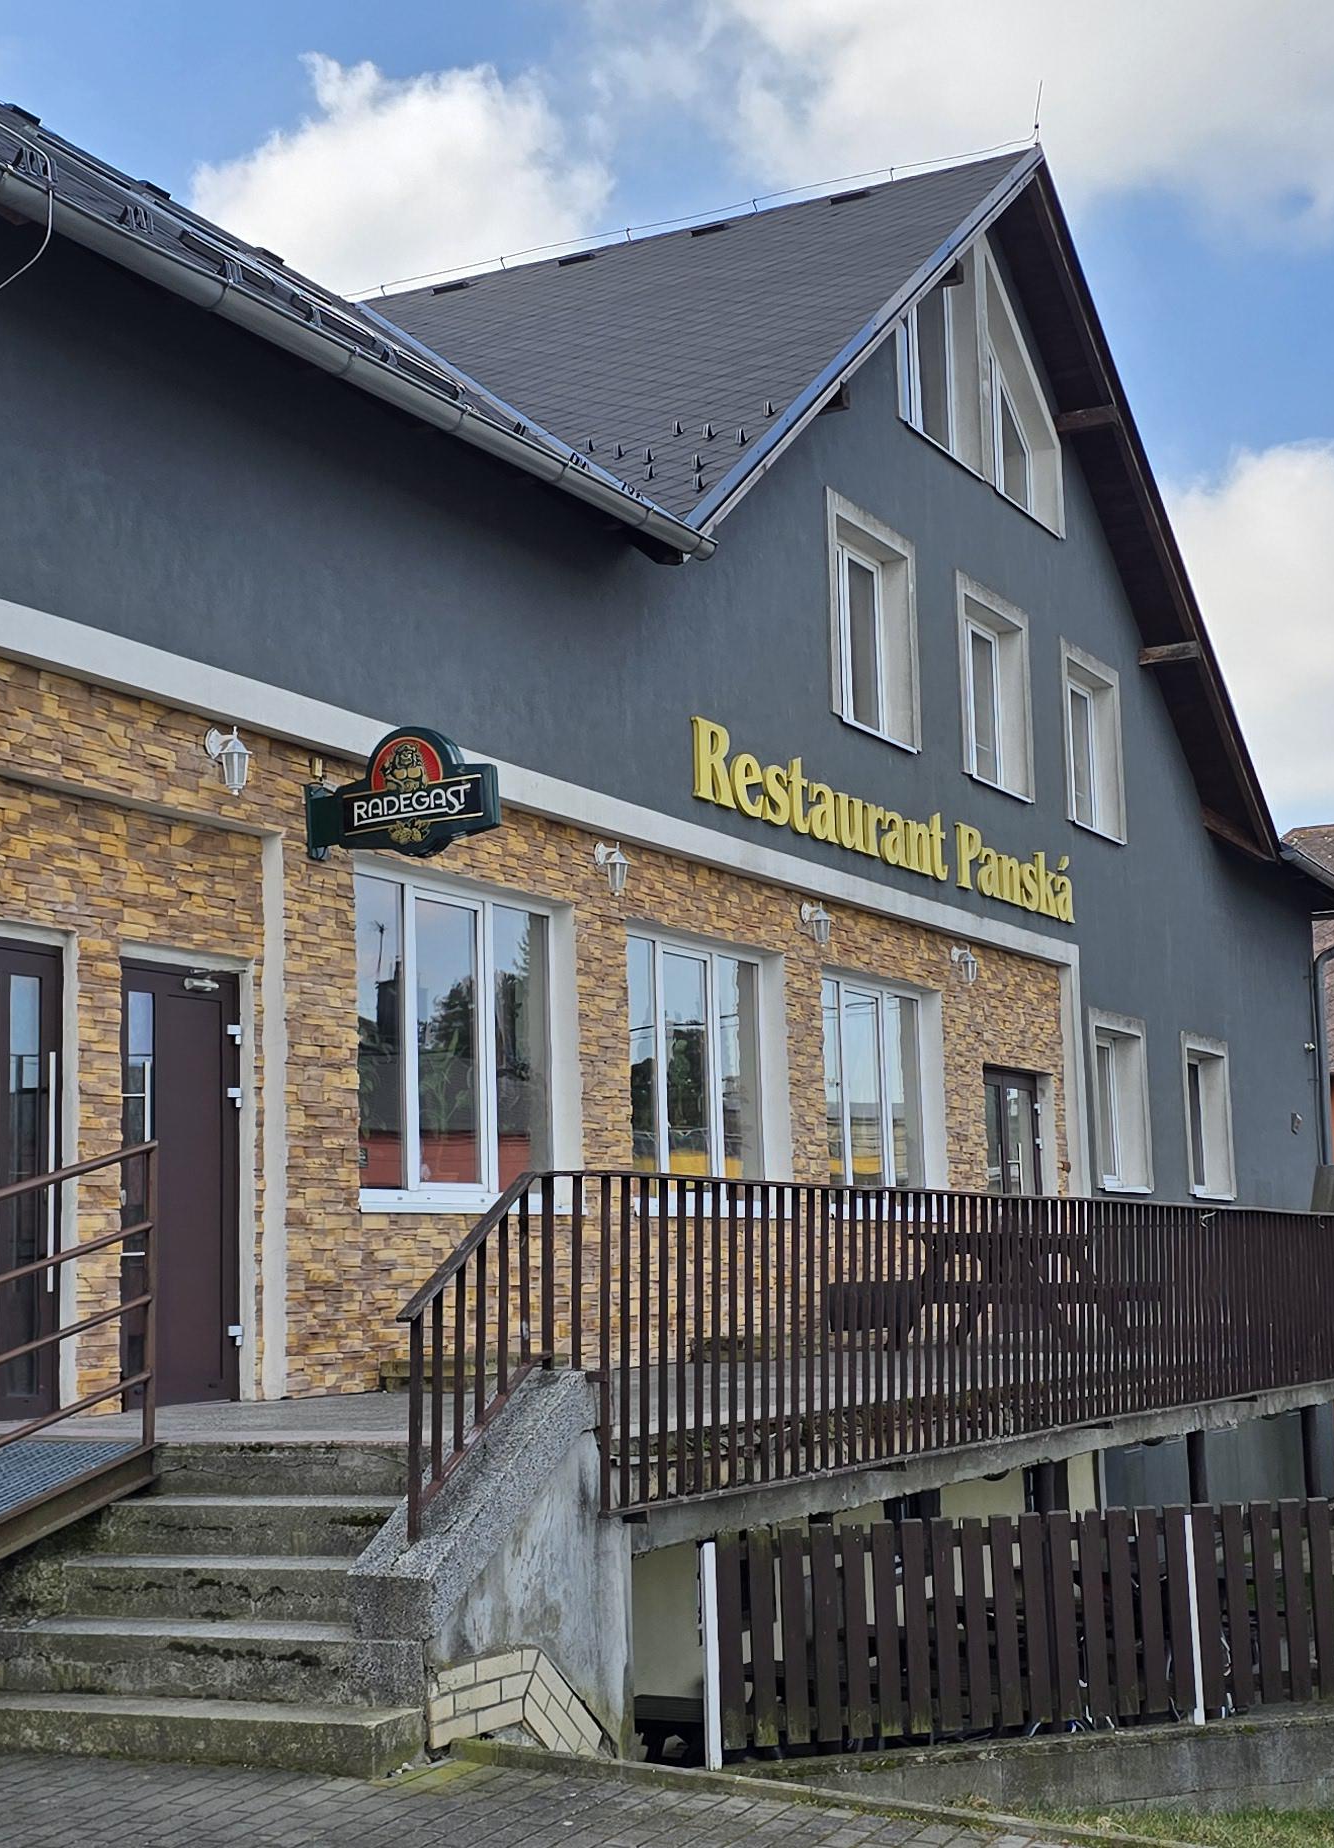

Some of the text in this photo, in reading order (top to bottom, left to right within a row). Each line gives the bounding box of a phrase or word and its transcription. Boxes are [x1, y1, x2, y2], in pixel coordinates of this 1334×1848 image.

[353, 783, 472, 827] RADEGAST
[690, 715, 1076, 924] Restaurant Panská
